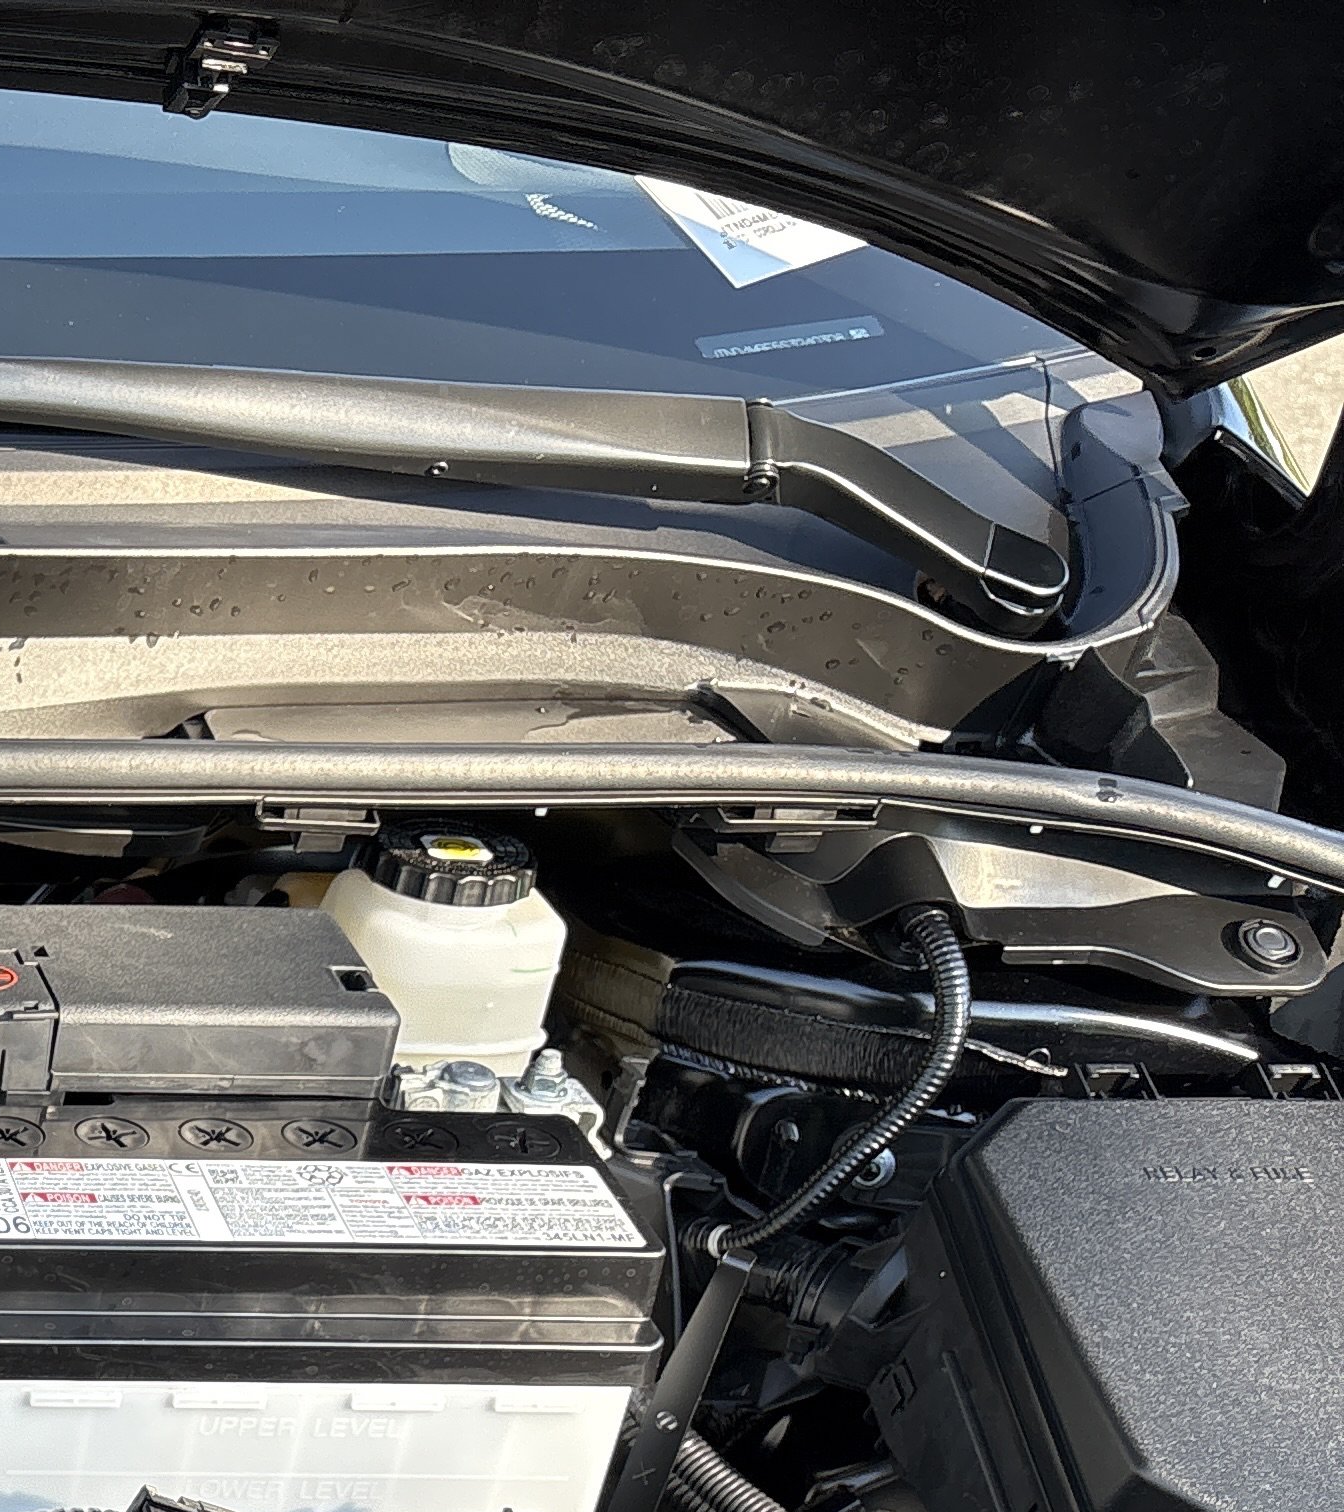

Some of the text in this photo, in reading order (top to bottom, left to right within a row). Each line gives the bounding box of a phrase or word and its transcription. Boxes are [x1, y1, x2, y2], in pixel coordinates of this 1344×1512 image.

[33, 1162, 165, 1172] DANGER EXPLOSIVE GASES
[1143, 1166, 1218, 1183] RELAY
[46, 1194, 91, 1203] POISON
[144, 1214, 168, 1222] NOT
[32, 1220, 55, 1228] KEEP
[57, 1220, 74, 1228] OUT
[106, 1221, 137, 1229] REACH
[88, 1228, 113, 1236] CAPS
[166, 1229, 196, 1237] LEVEL
[199, 1416, 402, 1438] UPPER LEVEL
[185, 1479, 379, 1500] LOWER LEVEL
